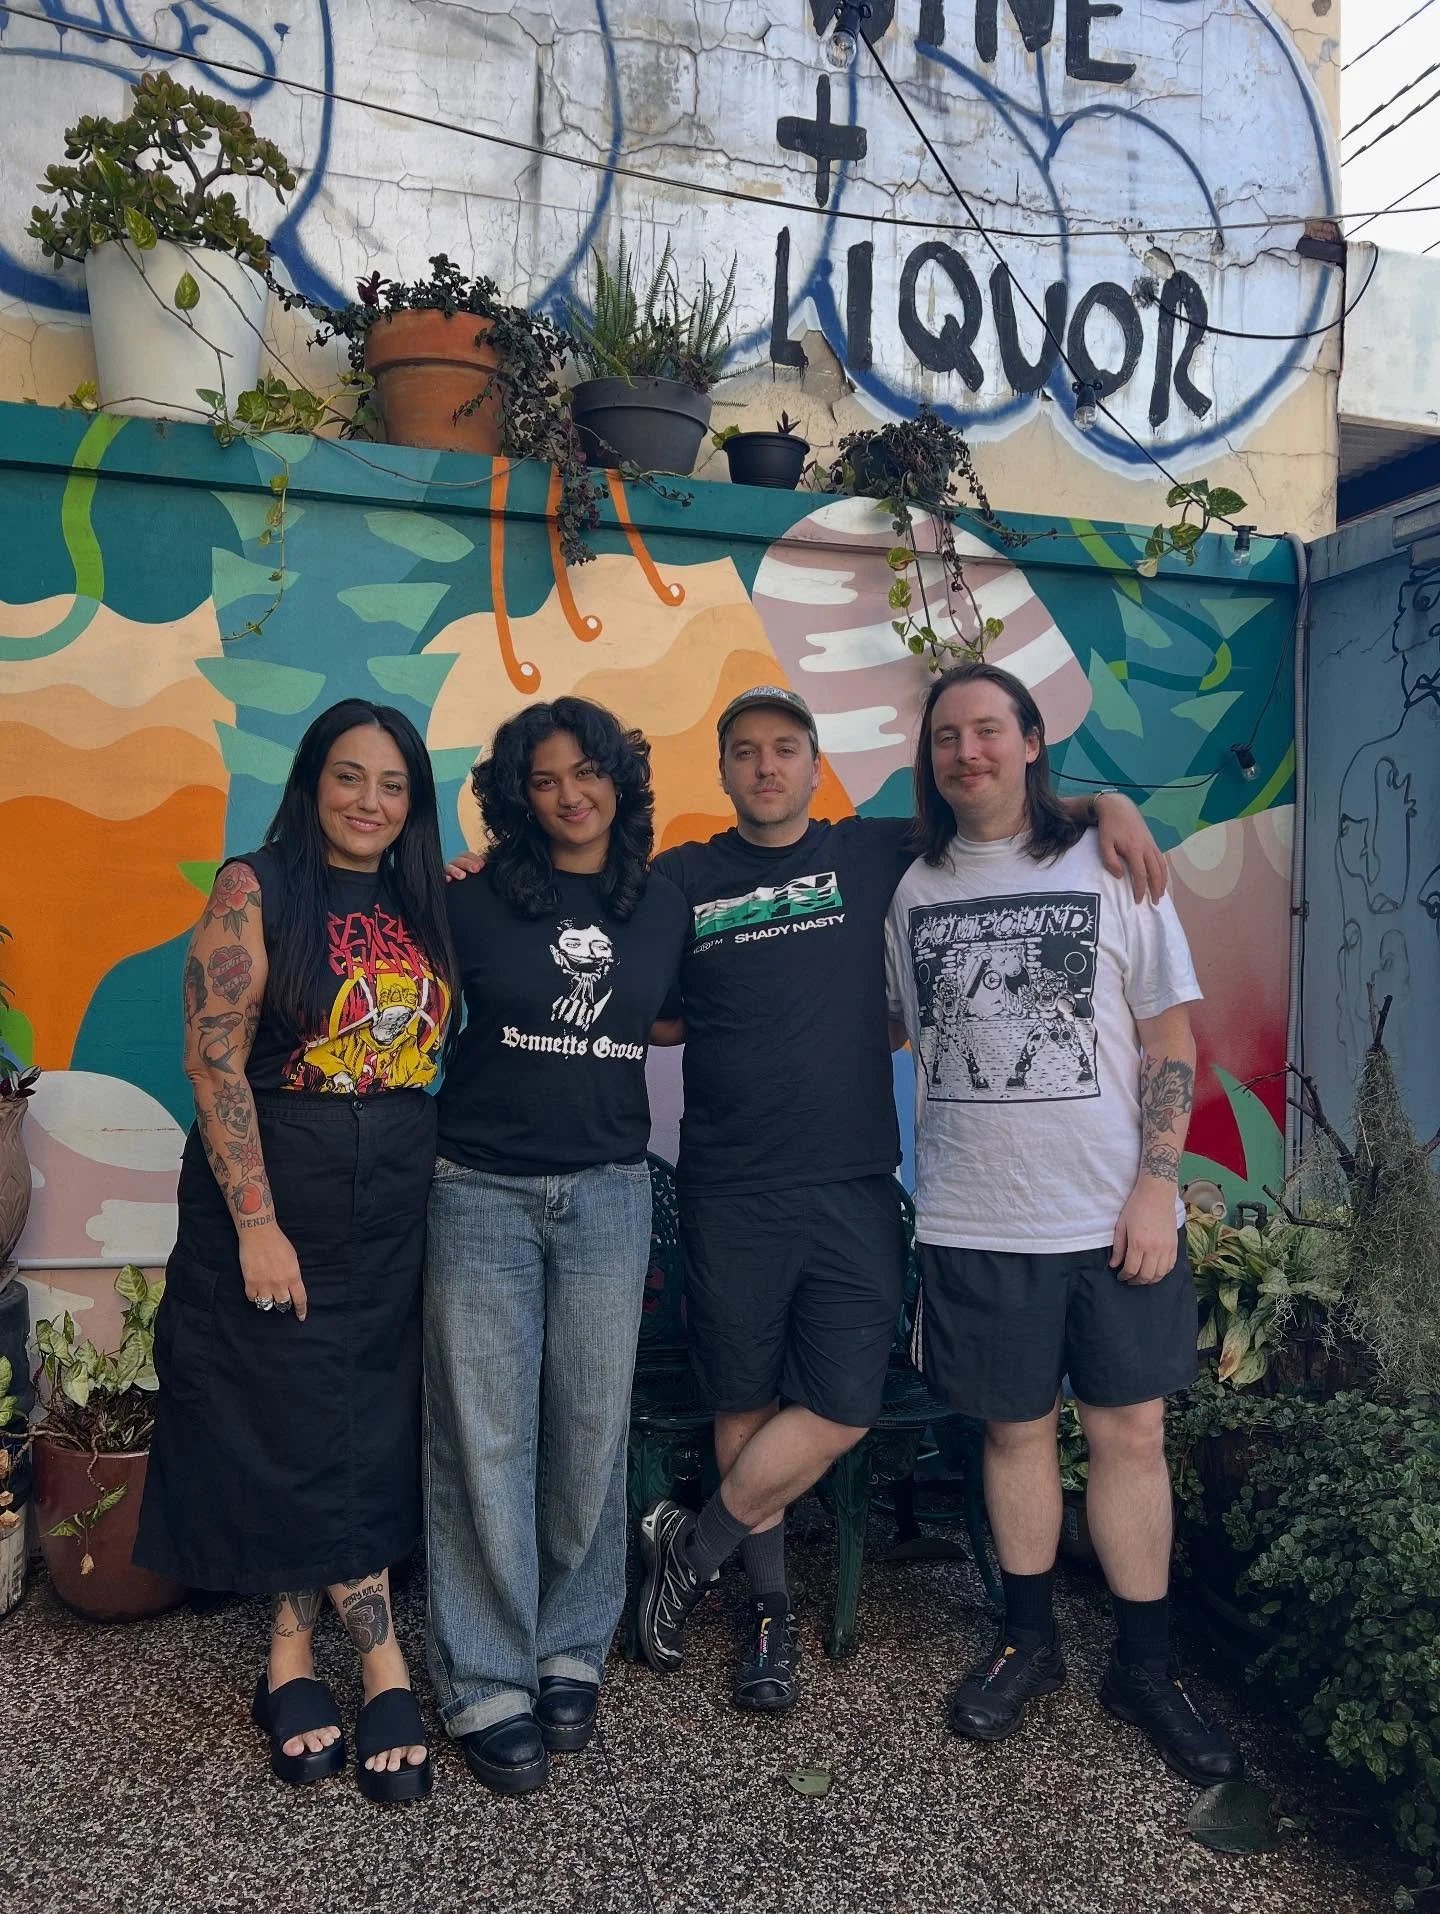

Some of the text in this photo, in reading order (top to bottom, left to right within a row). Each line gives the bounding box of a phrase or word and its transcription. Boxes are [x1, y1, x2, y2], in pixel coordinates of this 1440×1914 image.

[770, 226, 1213, 428] LIQUOR
[734, 914, 846, 944] SHADY NASTY
[914, 904, 1094, 949] COMPOUND
[501, 1026, 644, 1060] Bennetts Grove
